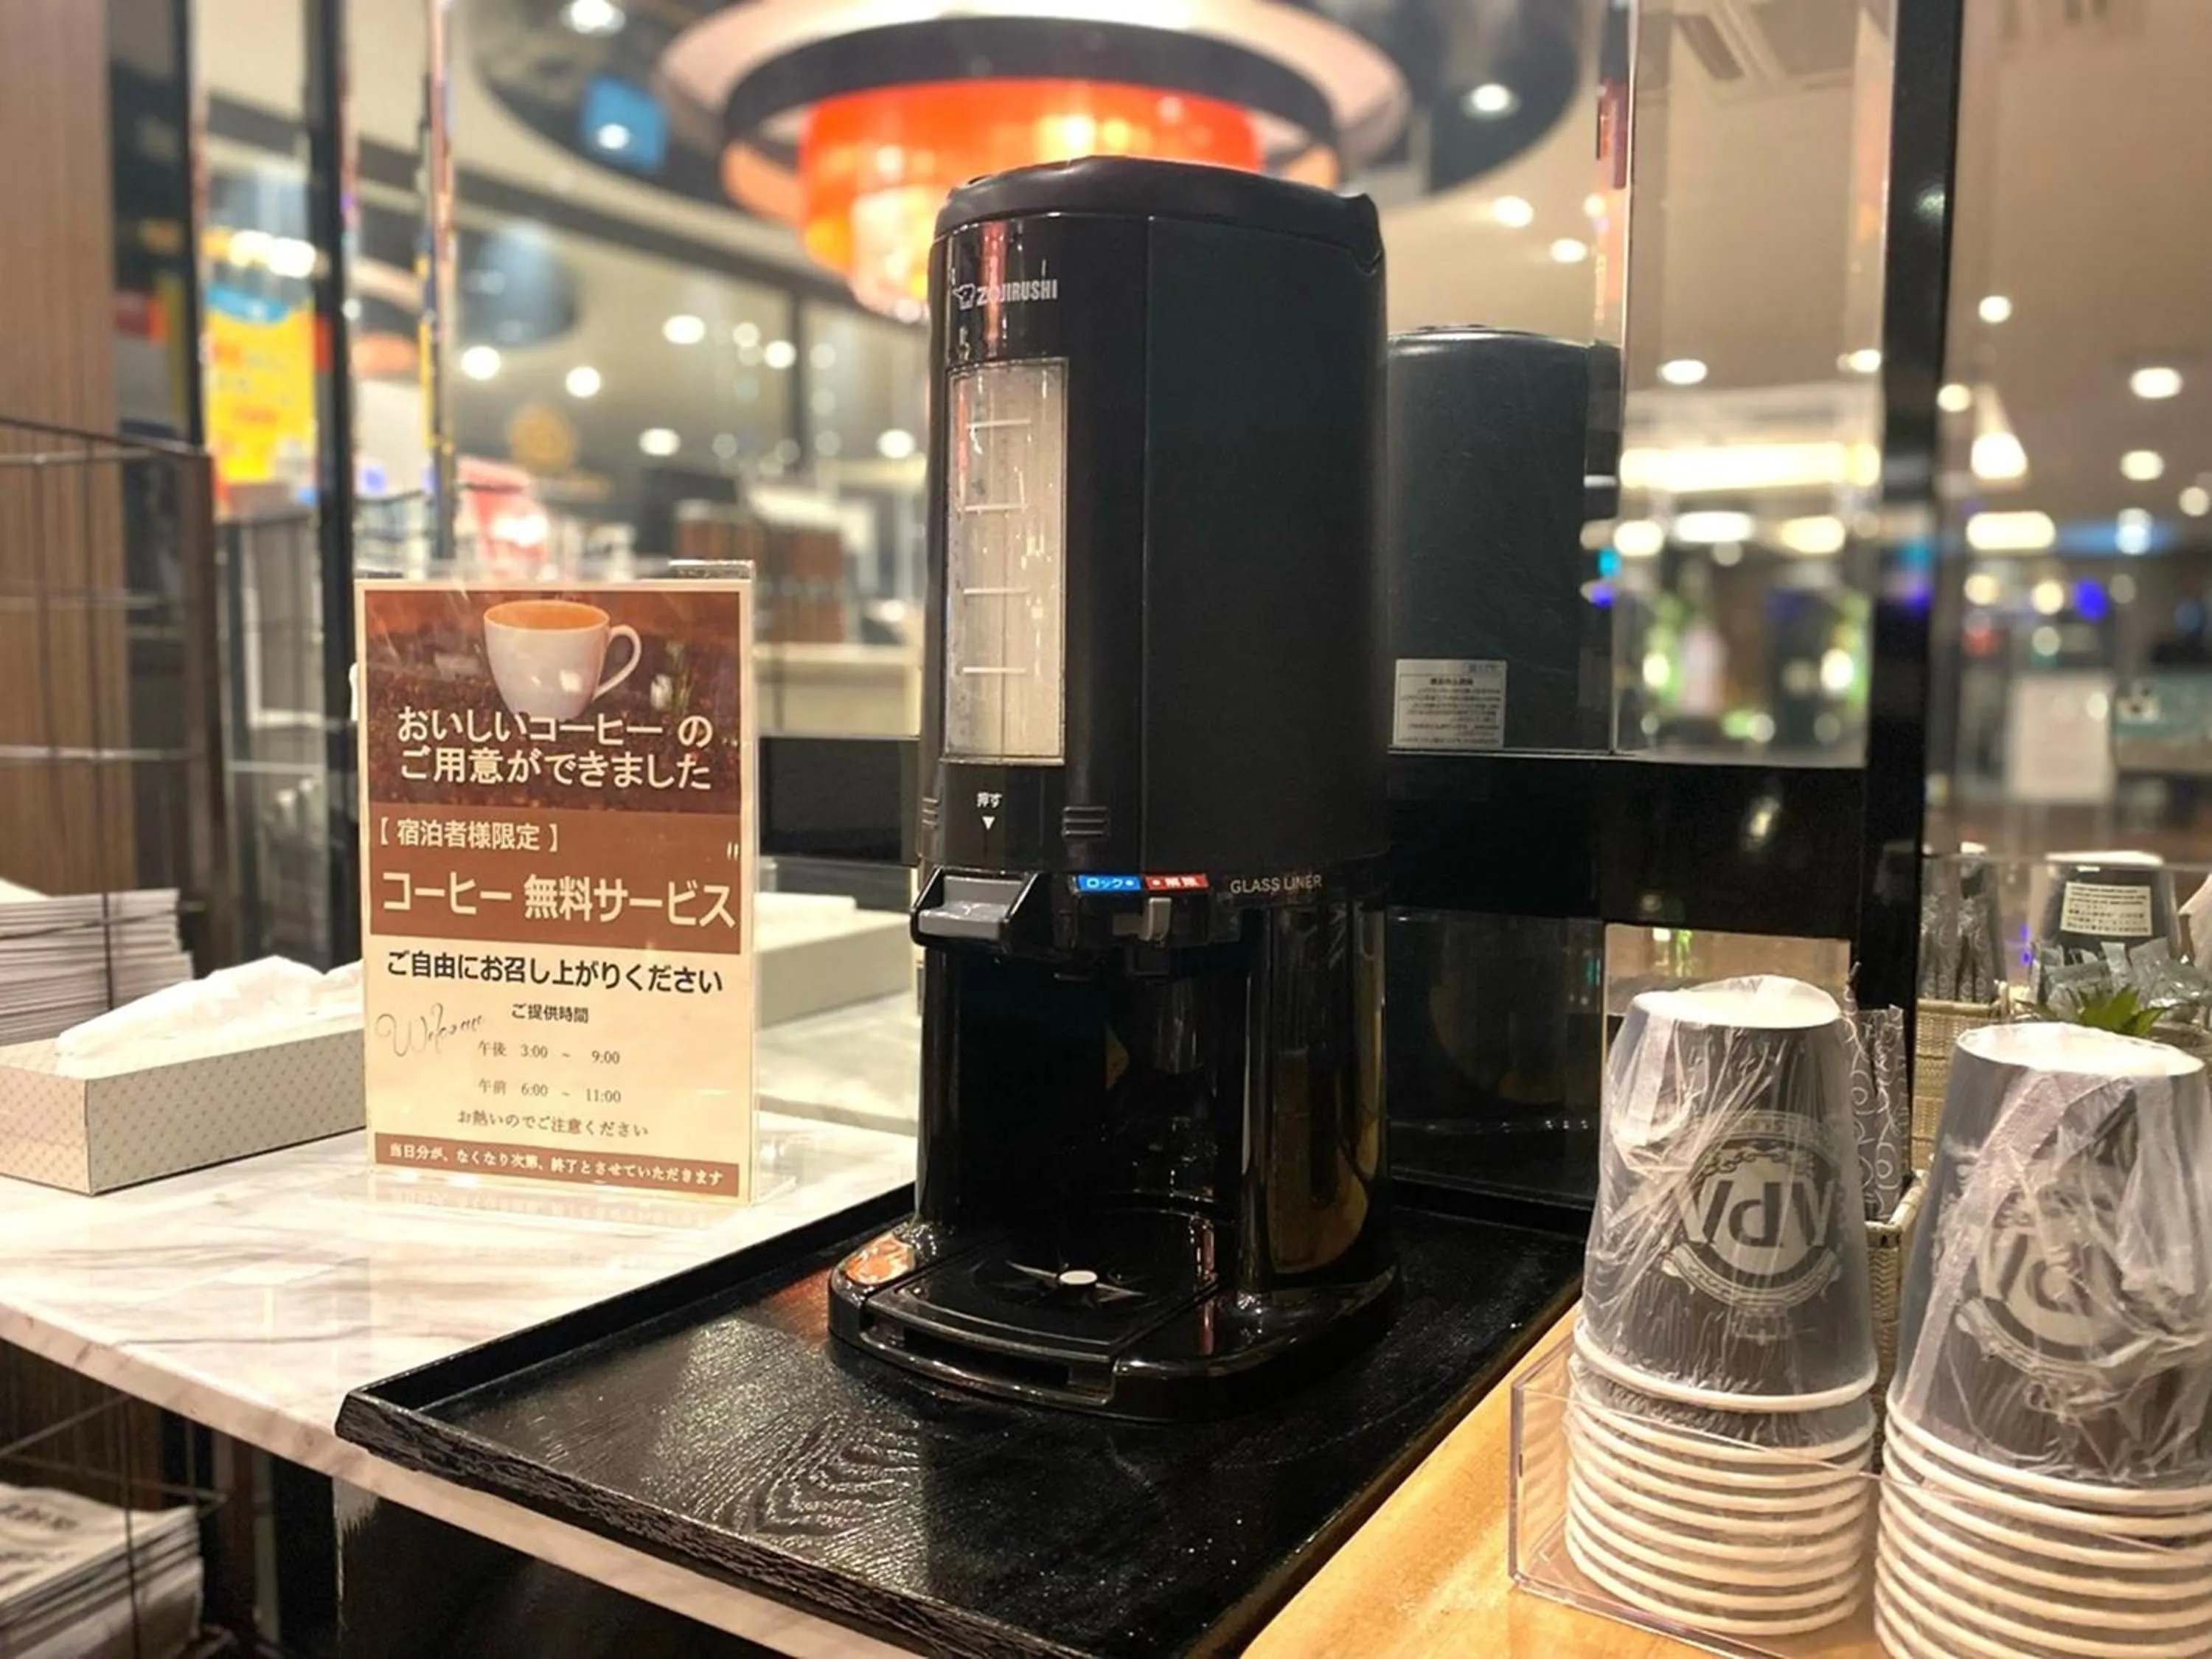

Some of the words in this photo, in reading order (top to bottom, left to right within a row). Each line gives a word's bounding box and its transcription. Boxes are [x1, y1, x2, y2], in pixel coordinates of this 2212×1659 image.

[398, 706, 663, 746] おいしいコーヒー
[678, 715, 714, 748] の
[400, 747, 712, 790] ご用意ができました
[1229, 876, 1281, 894] GLASS
[1283, 873, 1323, 891] LINER
[383, 871, 512, 916] コーヒー
[523, 874, 737, 928] 無料サービス
[387, 950, 723, 994] ご自由にお召し上がりください
[511, 1003, 589, 1024] ご提供時間
[478, 1040, 507, 1058] 午後
[520, 1043, 549, 1059] 3:00
[591, 1049, 621, 1065] 9:00
[478, 1077, 507, 1096] 午前
[521, 1082, 549, 1097] 6:00
[585, 1088, 622, 1103] 11:00
[457, 1109, 650, 1138] お熱いのでご注意ください
